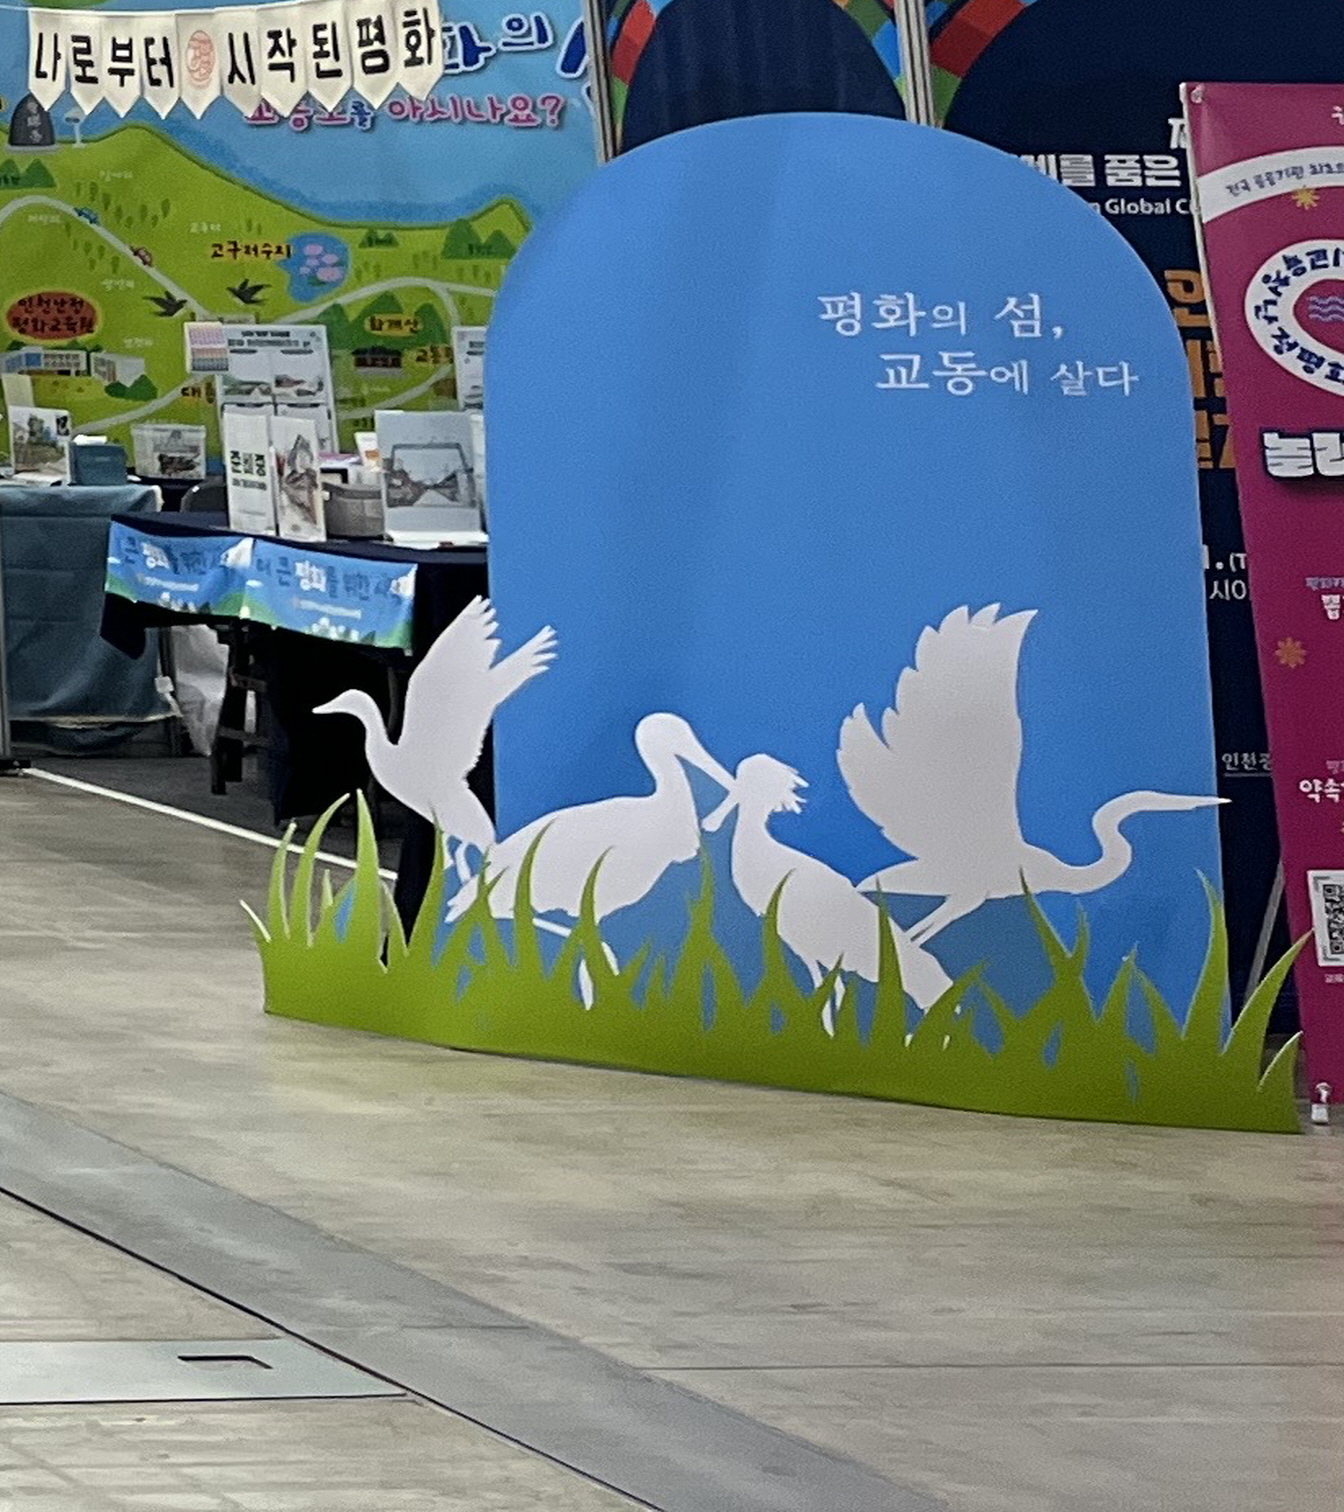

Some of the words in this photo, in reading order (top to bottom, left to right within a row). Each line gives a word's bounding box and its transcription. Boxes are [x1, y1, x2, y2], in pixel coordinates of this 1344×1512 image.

[387, 93, 563, 128] 아시나요?
[1104, 154, 1181, 187] 품은
[1105, 197, 1170, 216] Global
[817, 291, 968, 338] 평화의
[995, 292, 1065, 339] 섬,
[875, 351, 1030, 398] 교동에
[1050, 360, 1140, 397] 살다
